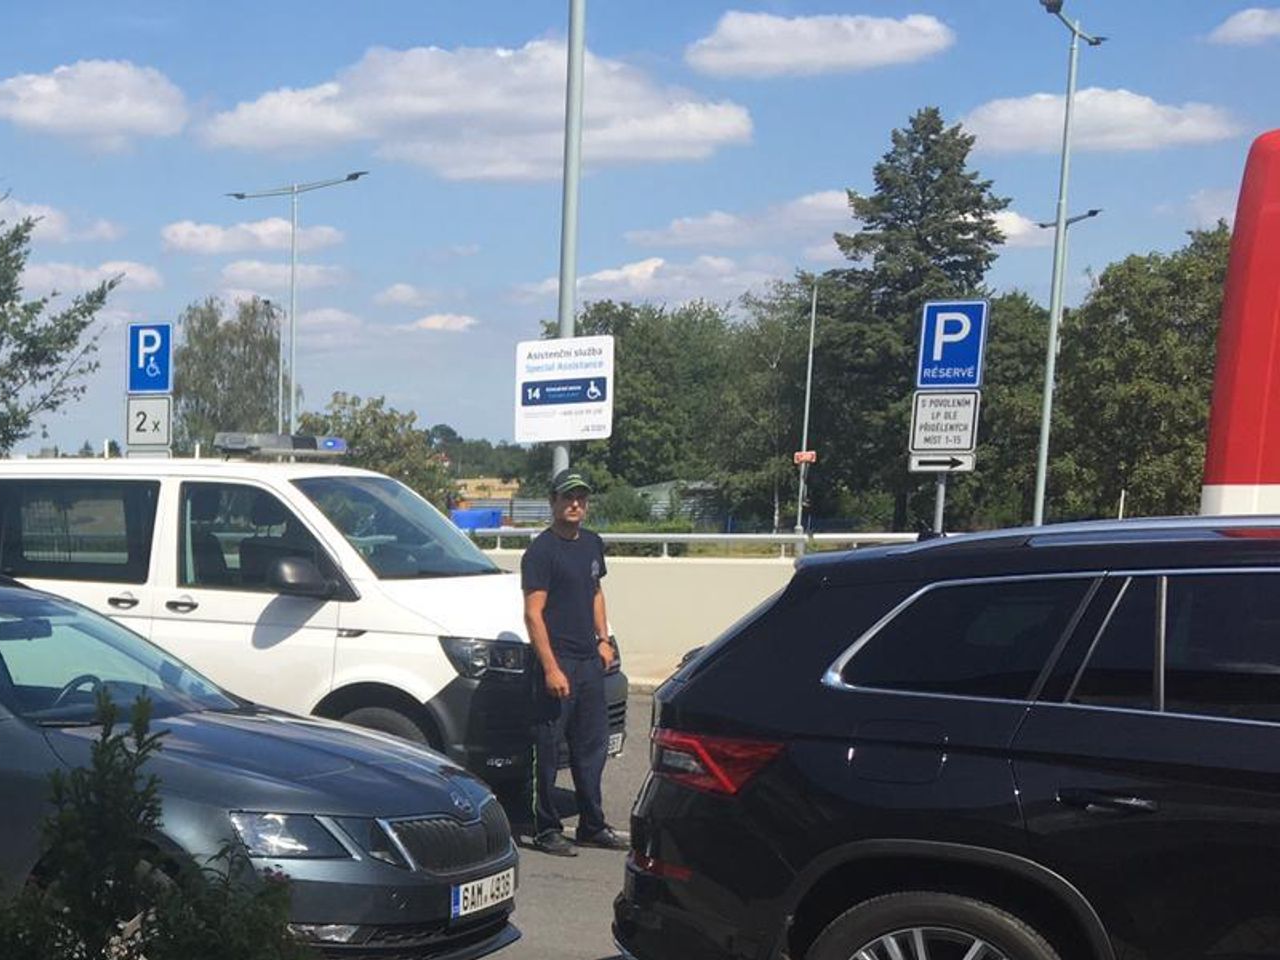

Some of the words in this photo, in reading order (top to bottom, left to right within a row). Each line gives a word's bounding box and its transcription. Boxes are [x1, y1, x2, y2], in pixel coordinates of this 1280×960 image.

[138, 328, 161, 369] P
[932, 312, 972, 361] P
[527, 348, 573, 360] Asistenční
[574, 346, 603, 357] služba
[527, 387, 540, 400] 14
